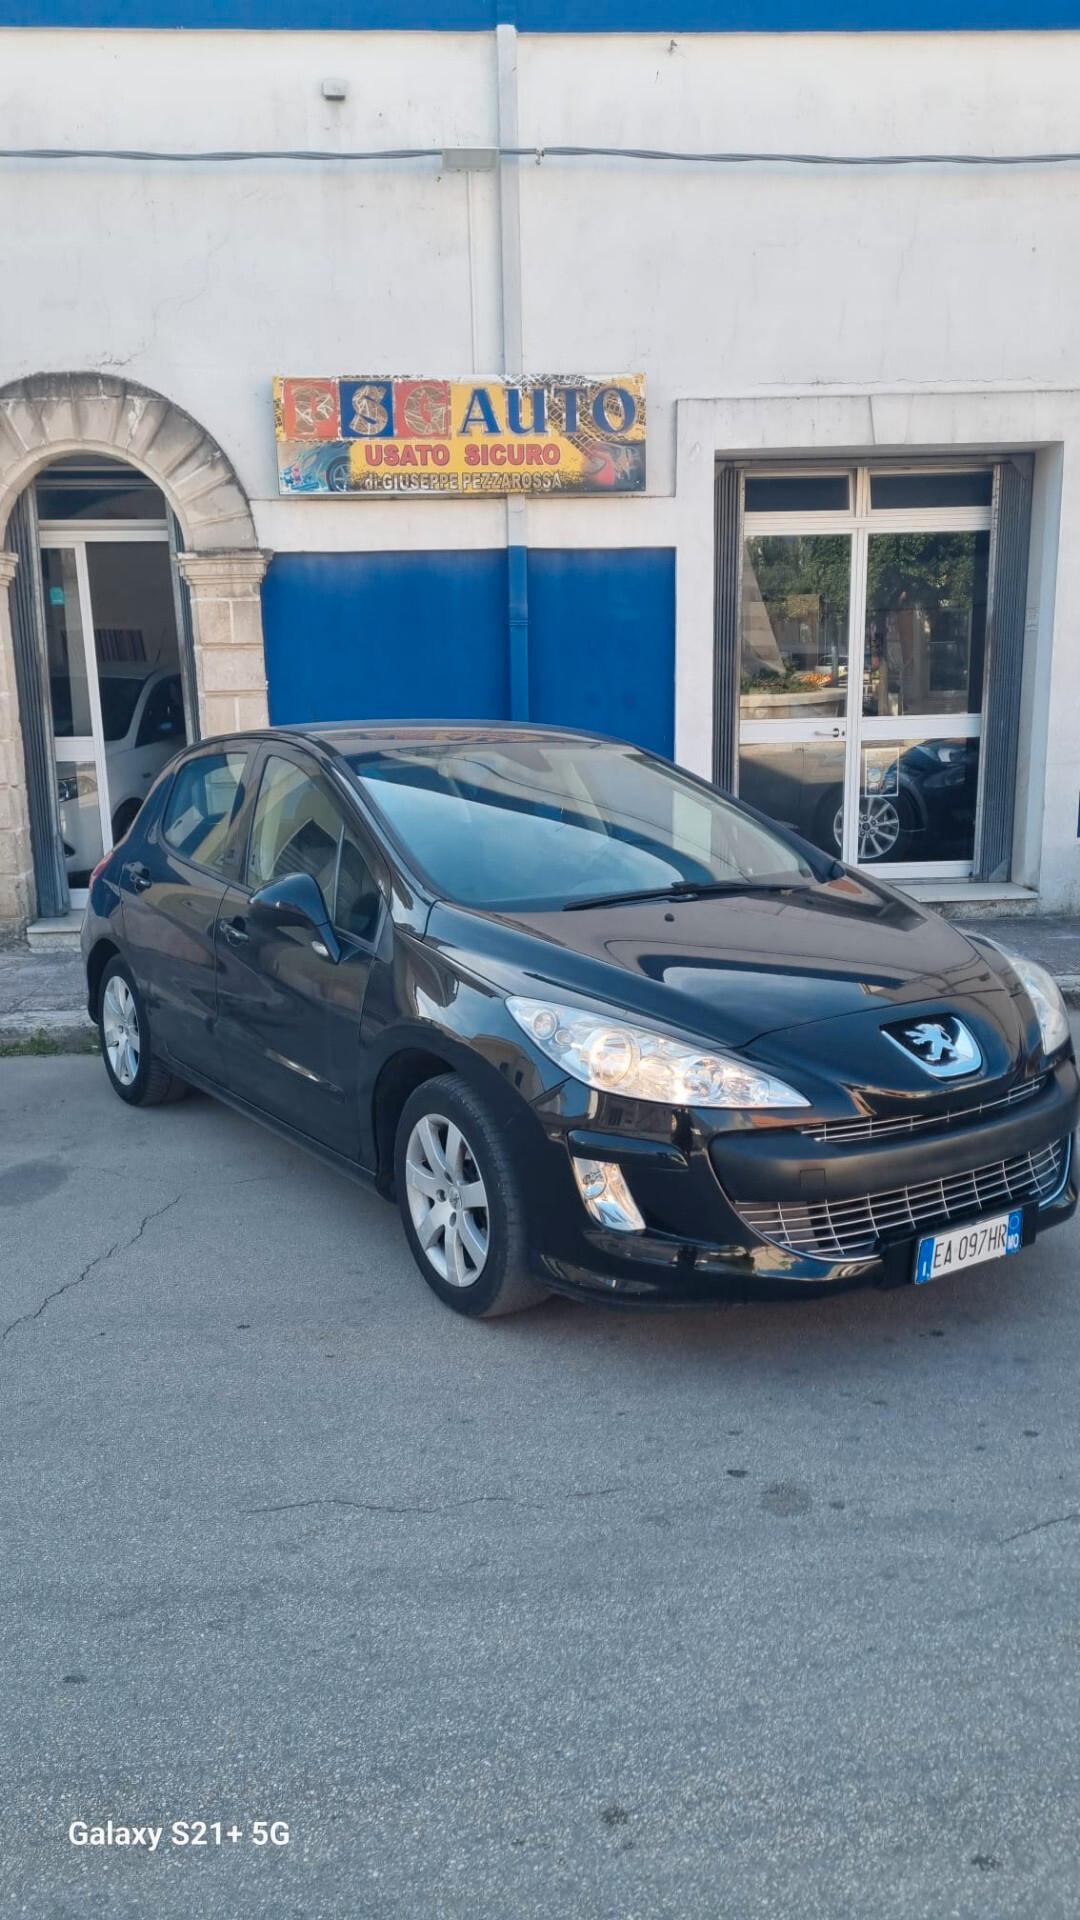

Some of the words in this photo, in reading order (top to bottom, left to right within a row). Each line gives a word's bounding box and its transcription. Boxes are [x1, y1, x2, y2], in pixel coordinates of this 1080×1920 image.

[458, 387, 636, 436] AUTO
[364, 444, 450, 467] USATO
[464, 443, 561, 466] SICURO
[382, 473, 459, 490] GIUSEPPE
[462, 472, 562, 489] PEZZAROSSA
[933, 1240, 953, 1269] EA
[958, 1223, 1007, 1261] 097HR
